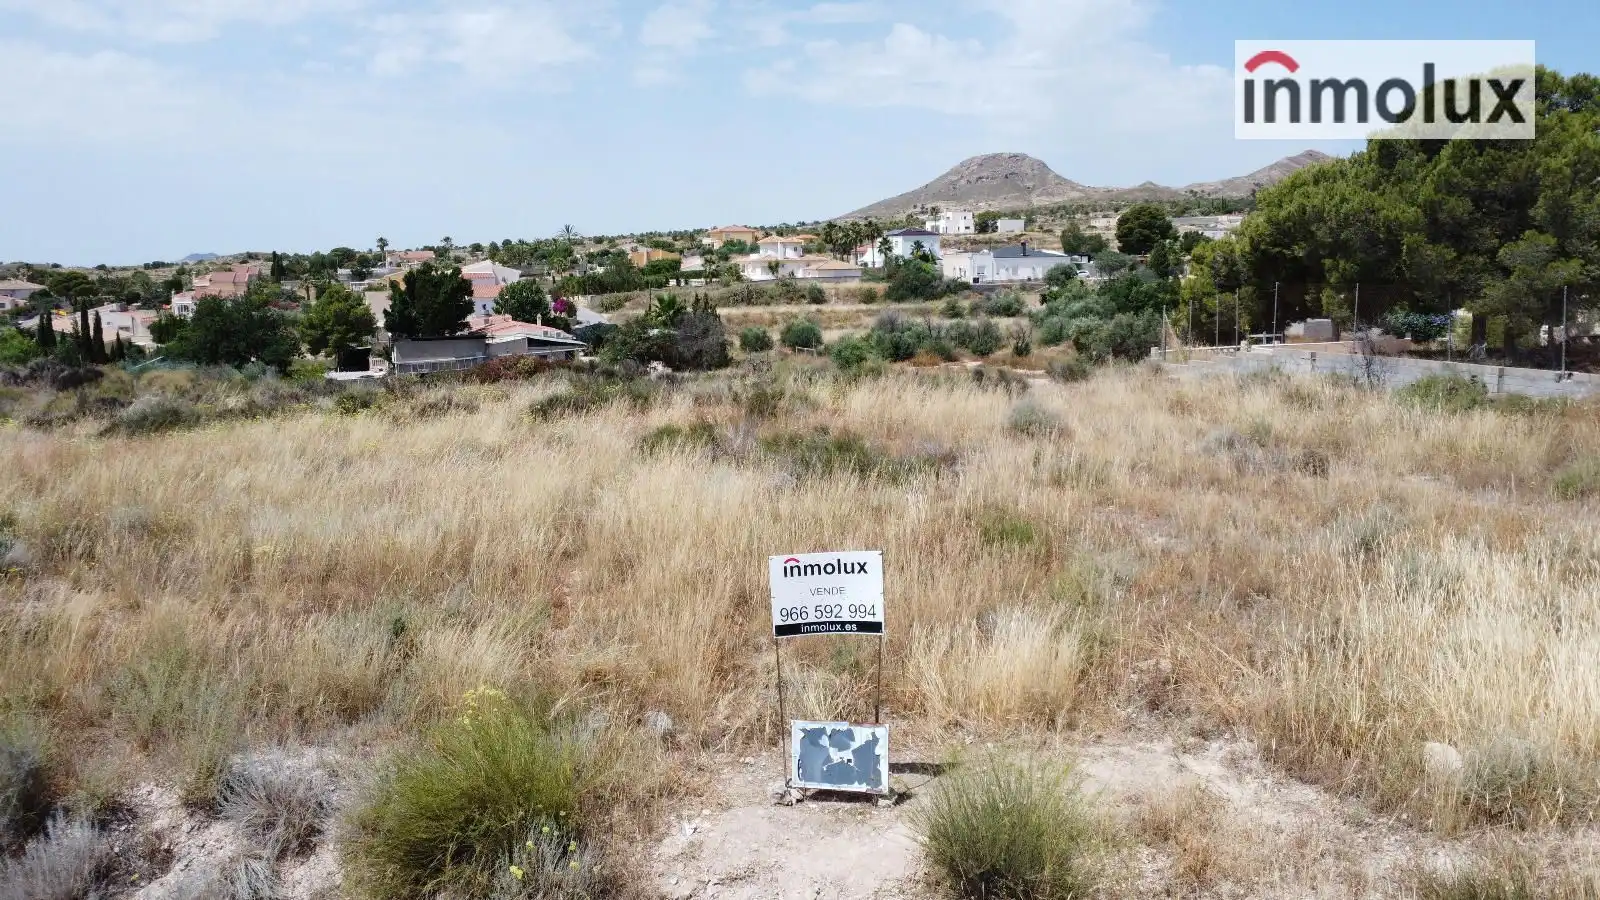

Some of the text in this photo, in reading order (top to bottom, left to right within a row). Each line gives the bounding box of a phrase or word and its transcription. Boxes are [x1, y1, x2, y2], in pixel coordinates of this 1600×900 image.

[784, 558, 868, 577] inmolux
[809, 587, 846, 596] VENDE
[780, 603, 877, 622] 966 592 994
[801, 623, 857, 632] inmolux.es
